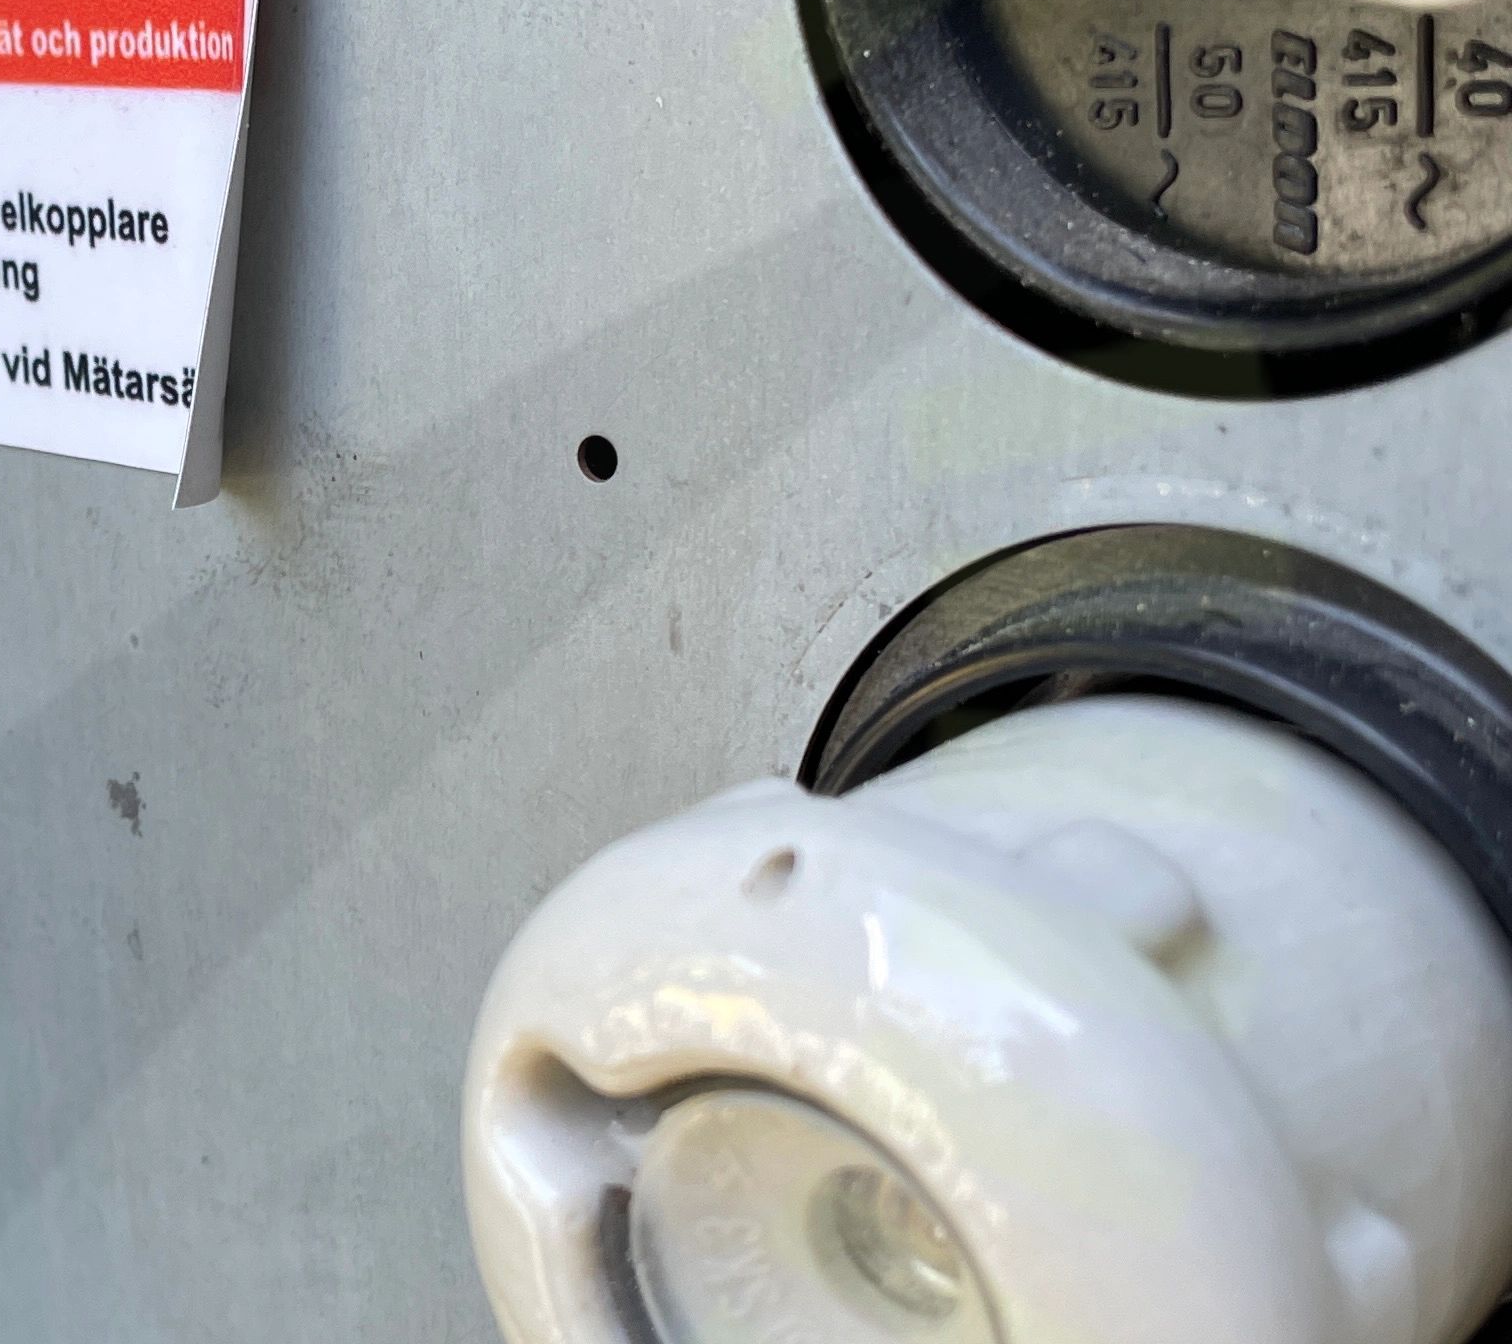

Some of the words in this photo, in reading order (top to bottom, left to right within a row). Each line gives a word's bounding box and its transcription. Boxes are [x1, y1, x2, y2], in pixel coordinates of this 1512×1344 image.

[31, 20, 81, 58] och
[90, 19, 234, 67] produktion
[1190, 41, 1244, 120] 50
[1340, 28, 1399, 132] 415
[1456, 38, 1512, 118] 40
[1, 196, 169, 246] elkopplare
[1, 348, 52, 388] vid
